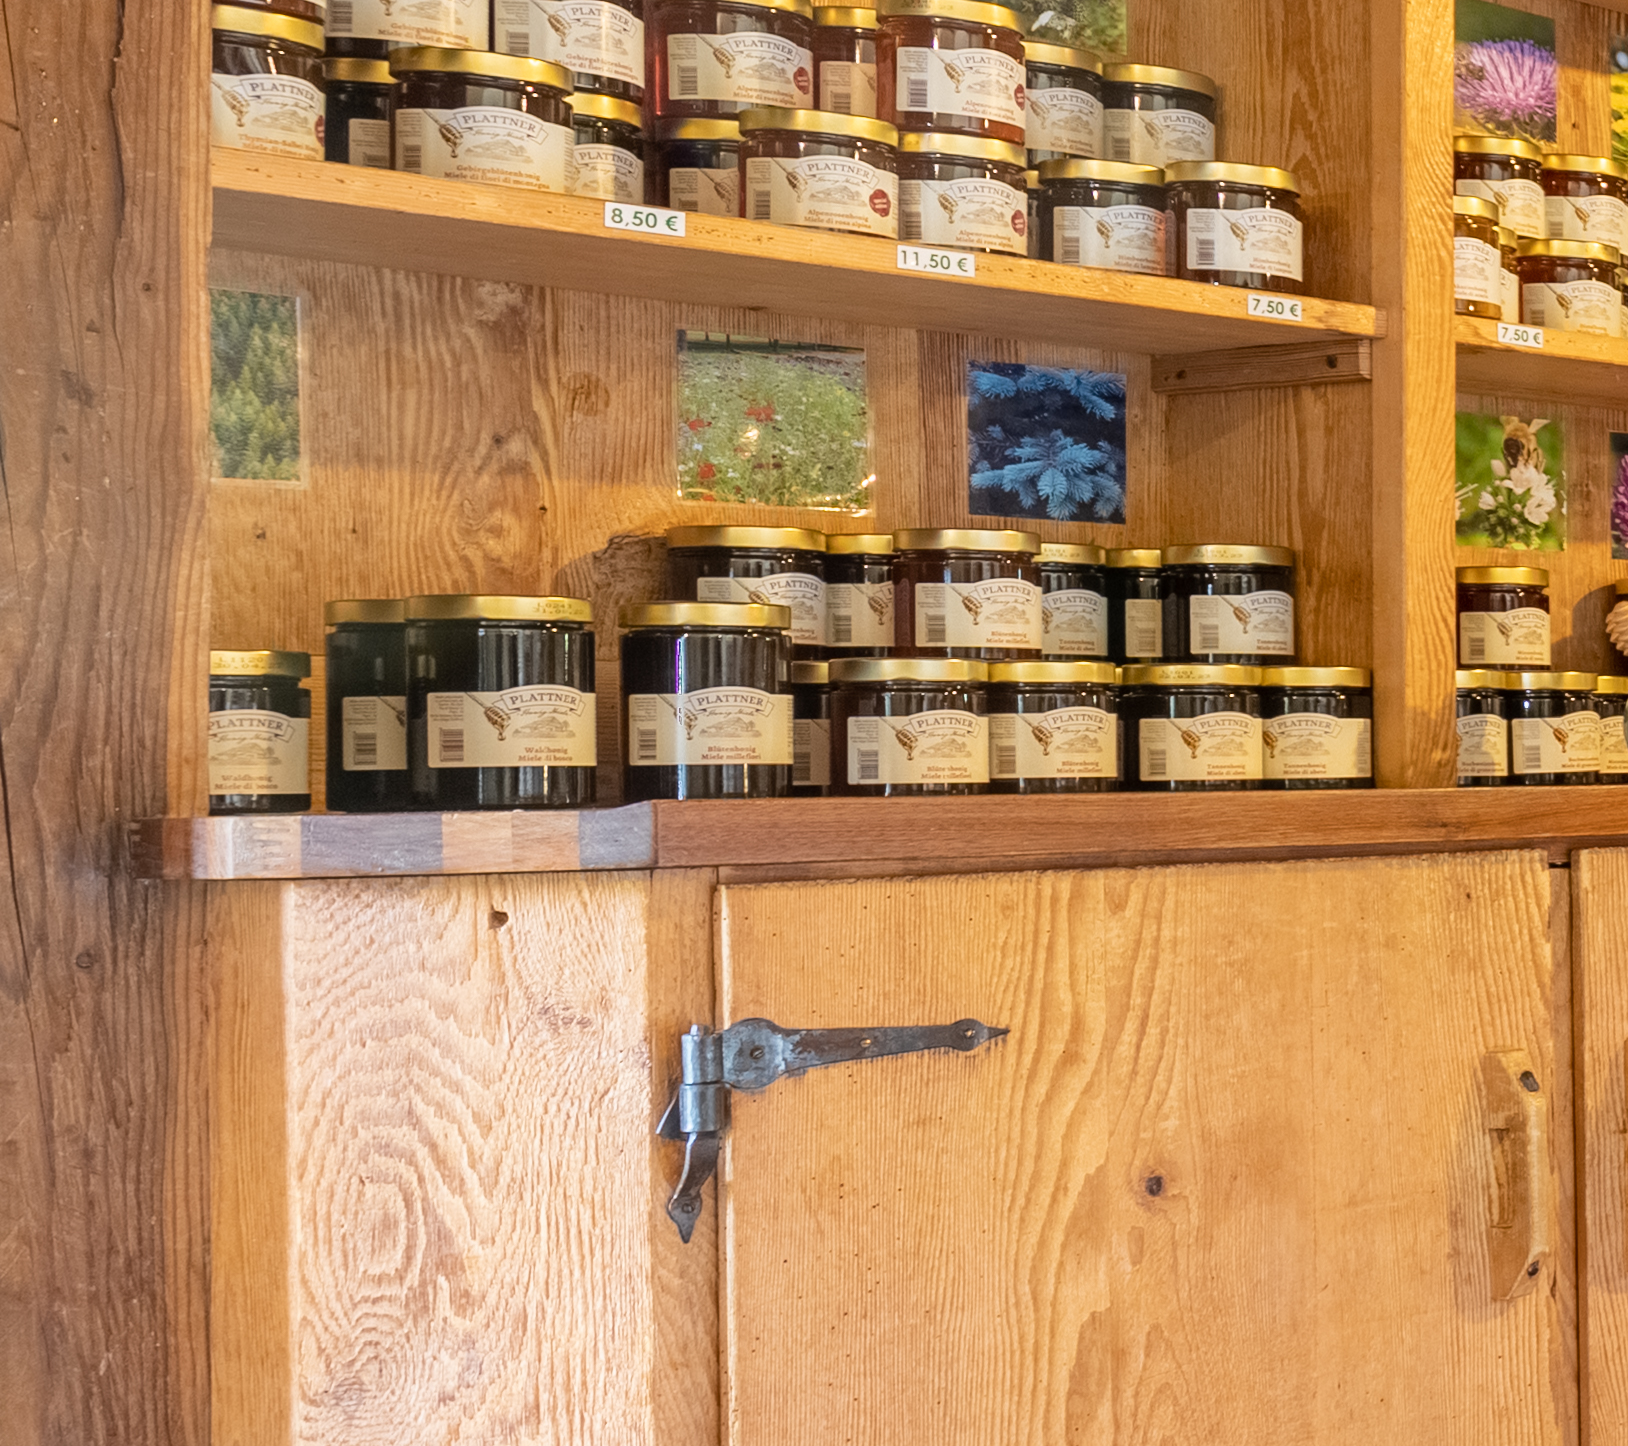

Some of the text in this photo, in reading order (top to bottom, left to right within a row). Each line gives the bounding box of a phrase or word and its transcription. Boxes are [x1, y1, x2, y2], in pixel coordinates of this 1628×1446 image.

[735, 39, 794, 57] PLATTNER
[965, 55, 1017, 74] PLATTNER
[250, 82, 319, 102] PLATTNER
[1049, 93, 1095, 108] PLATTNER
[462, 114, 536, 134] PLATTNER
[1163, 114, 1207, 130] PLATTNER
[579, 151, 635, 170] PLATTNER
[807, 162, 870, 180] PLATTNER
[957, 185, 1012, 202] PLATTNER
[610, 207, 679, 232] 8,50 €
[808, 209, 869, 223] Alpenrosenhonig
[1113, 211, 1165, 226] PLATTNER
[1248, 214, 1293, 230] PLATTNER
[901, 250, 968, 272] 11,50 €
[1571, 286, 1611, 299] PLATTNER
[1252, 298, 1299, 317] 7,50 €
[1501, 327, 1541, 344] 7,50 €
[770, 579, 820, 593] PLATTNER
[981, 584, 1033, 598] PLATTNER
[1051, 595, 1099, 609] PLATTNER
[1250, 597, 1292, 610] PLATTNER
[509, 692, 577, 707] PLATTNER
[696, 695, 764, 707] PLATTNER
[208, 718, 284, 733] PLATTNER
[916, 716, 974, 729] PLATTNER
[1052, 713, 1105, 725] PLATTNER
[1199, 719, 1251, 731] PLATTNER
[1277, 719, 1331, 731] PLATTNER
[701, 752, 720, 760] Miele
[707, 745, 757, 754] Blütenhonig
[1283, 762, 1327, 771] Tannenhonig
